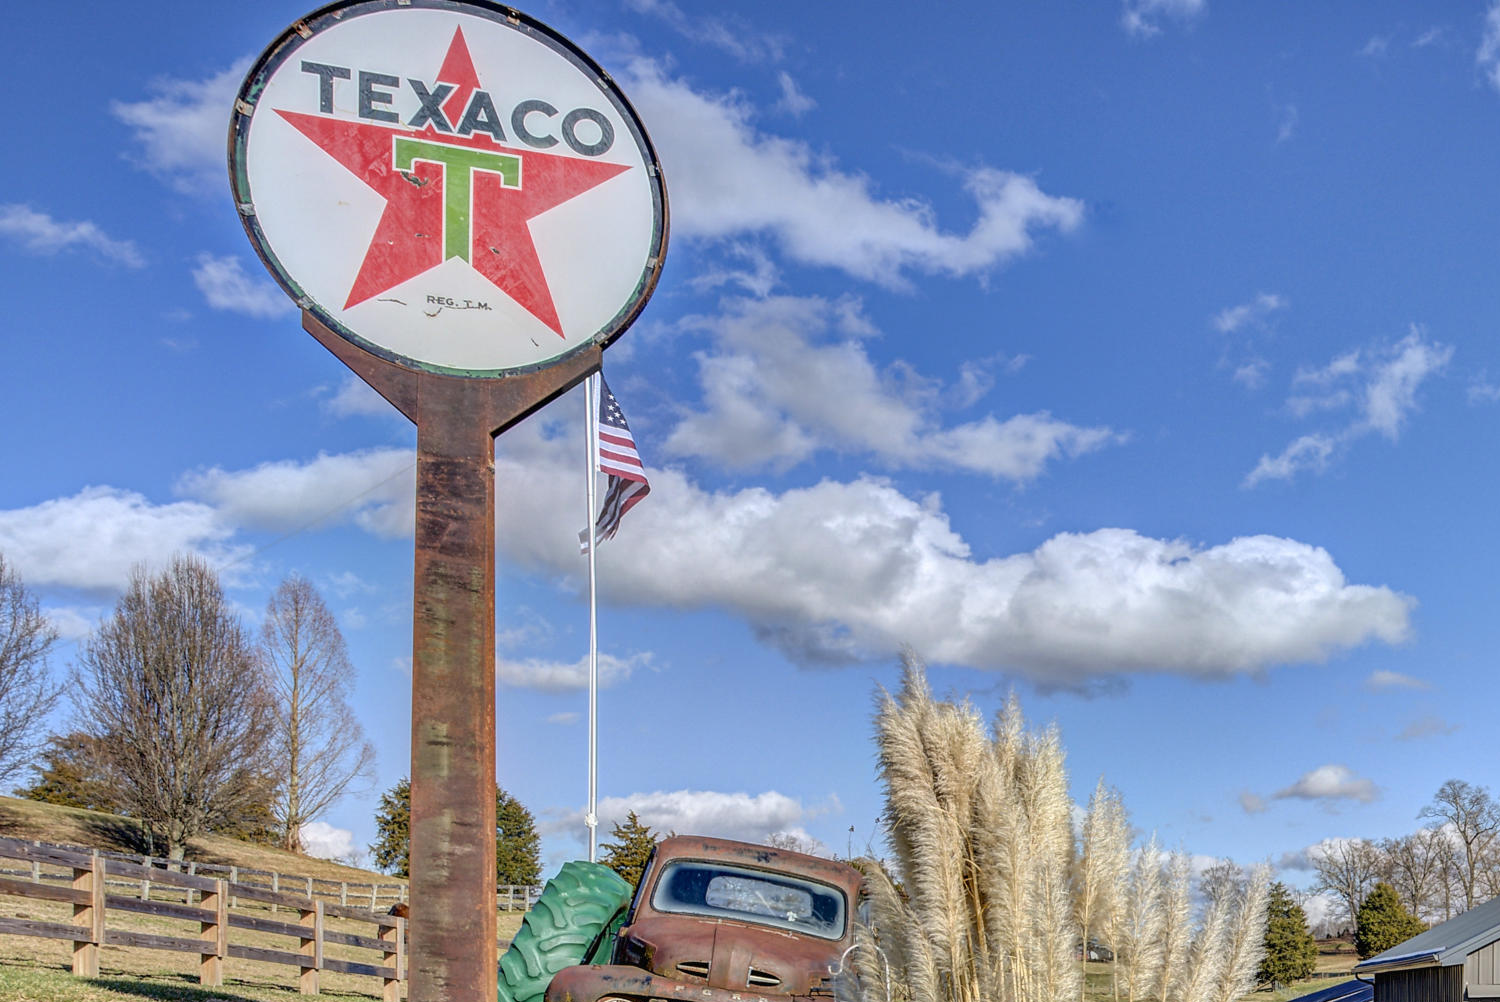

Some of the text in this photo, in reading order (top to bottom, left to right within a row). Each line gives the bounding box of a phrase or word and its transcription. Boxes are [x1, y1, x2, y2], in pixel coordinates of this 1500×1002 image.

[301, 60, 615, 157] TEXACO
[393, 136, 522, 265] T
[426, 295, 459, 306] REG.
